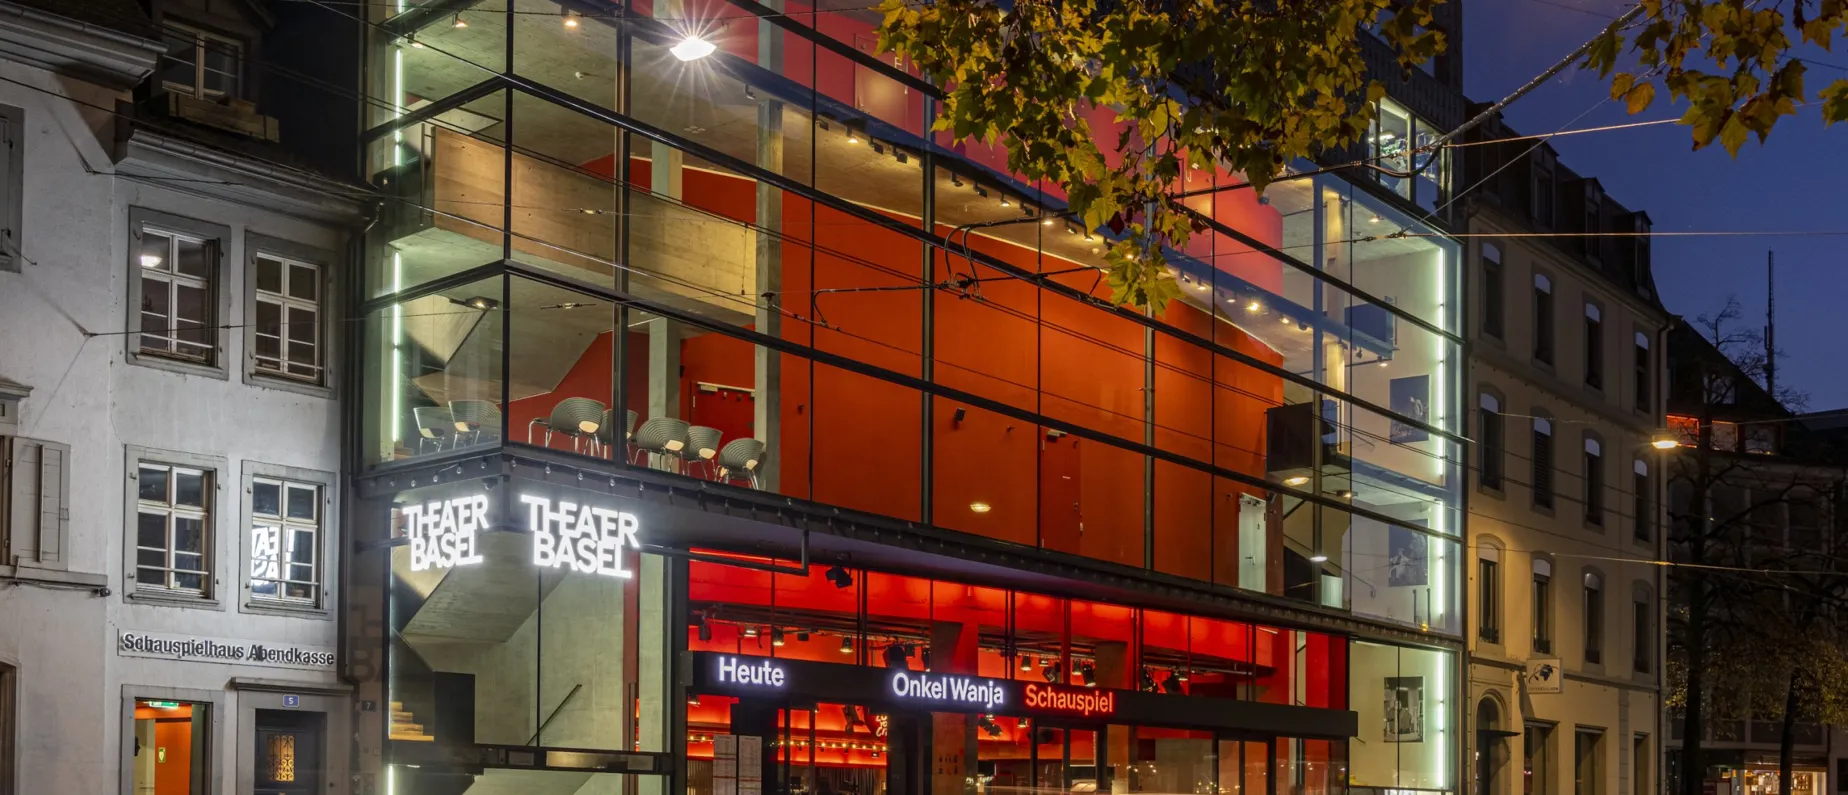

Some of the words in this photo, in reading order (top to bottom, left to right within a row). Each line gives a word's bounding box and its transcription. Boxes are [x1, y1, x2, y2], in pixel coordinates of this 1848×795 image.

[402, 494, 490, 540] THEATER
[520, 494, 640, 548] THEATER
[410, 526, 483, 572] BASEL
[533, 532, 632, 579] BASEL
[122, 633, 244, 659] Schauspielhaus
[247, 644, 335, 666] Abendkasse
[718, 657, 784, 686] Heute
[288, 697, 294, 705] 5
[893, 671, 948, 701] Onkel
[950, 677, 1004, 708] Wanja
[1025, 684, 1114, 716] Schauspiel
